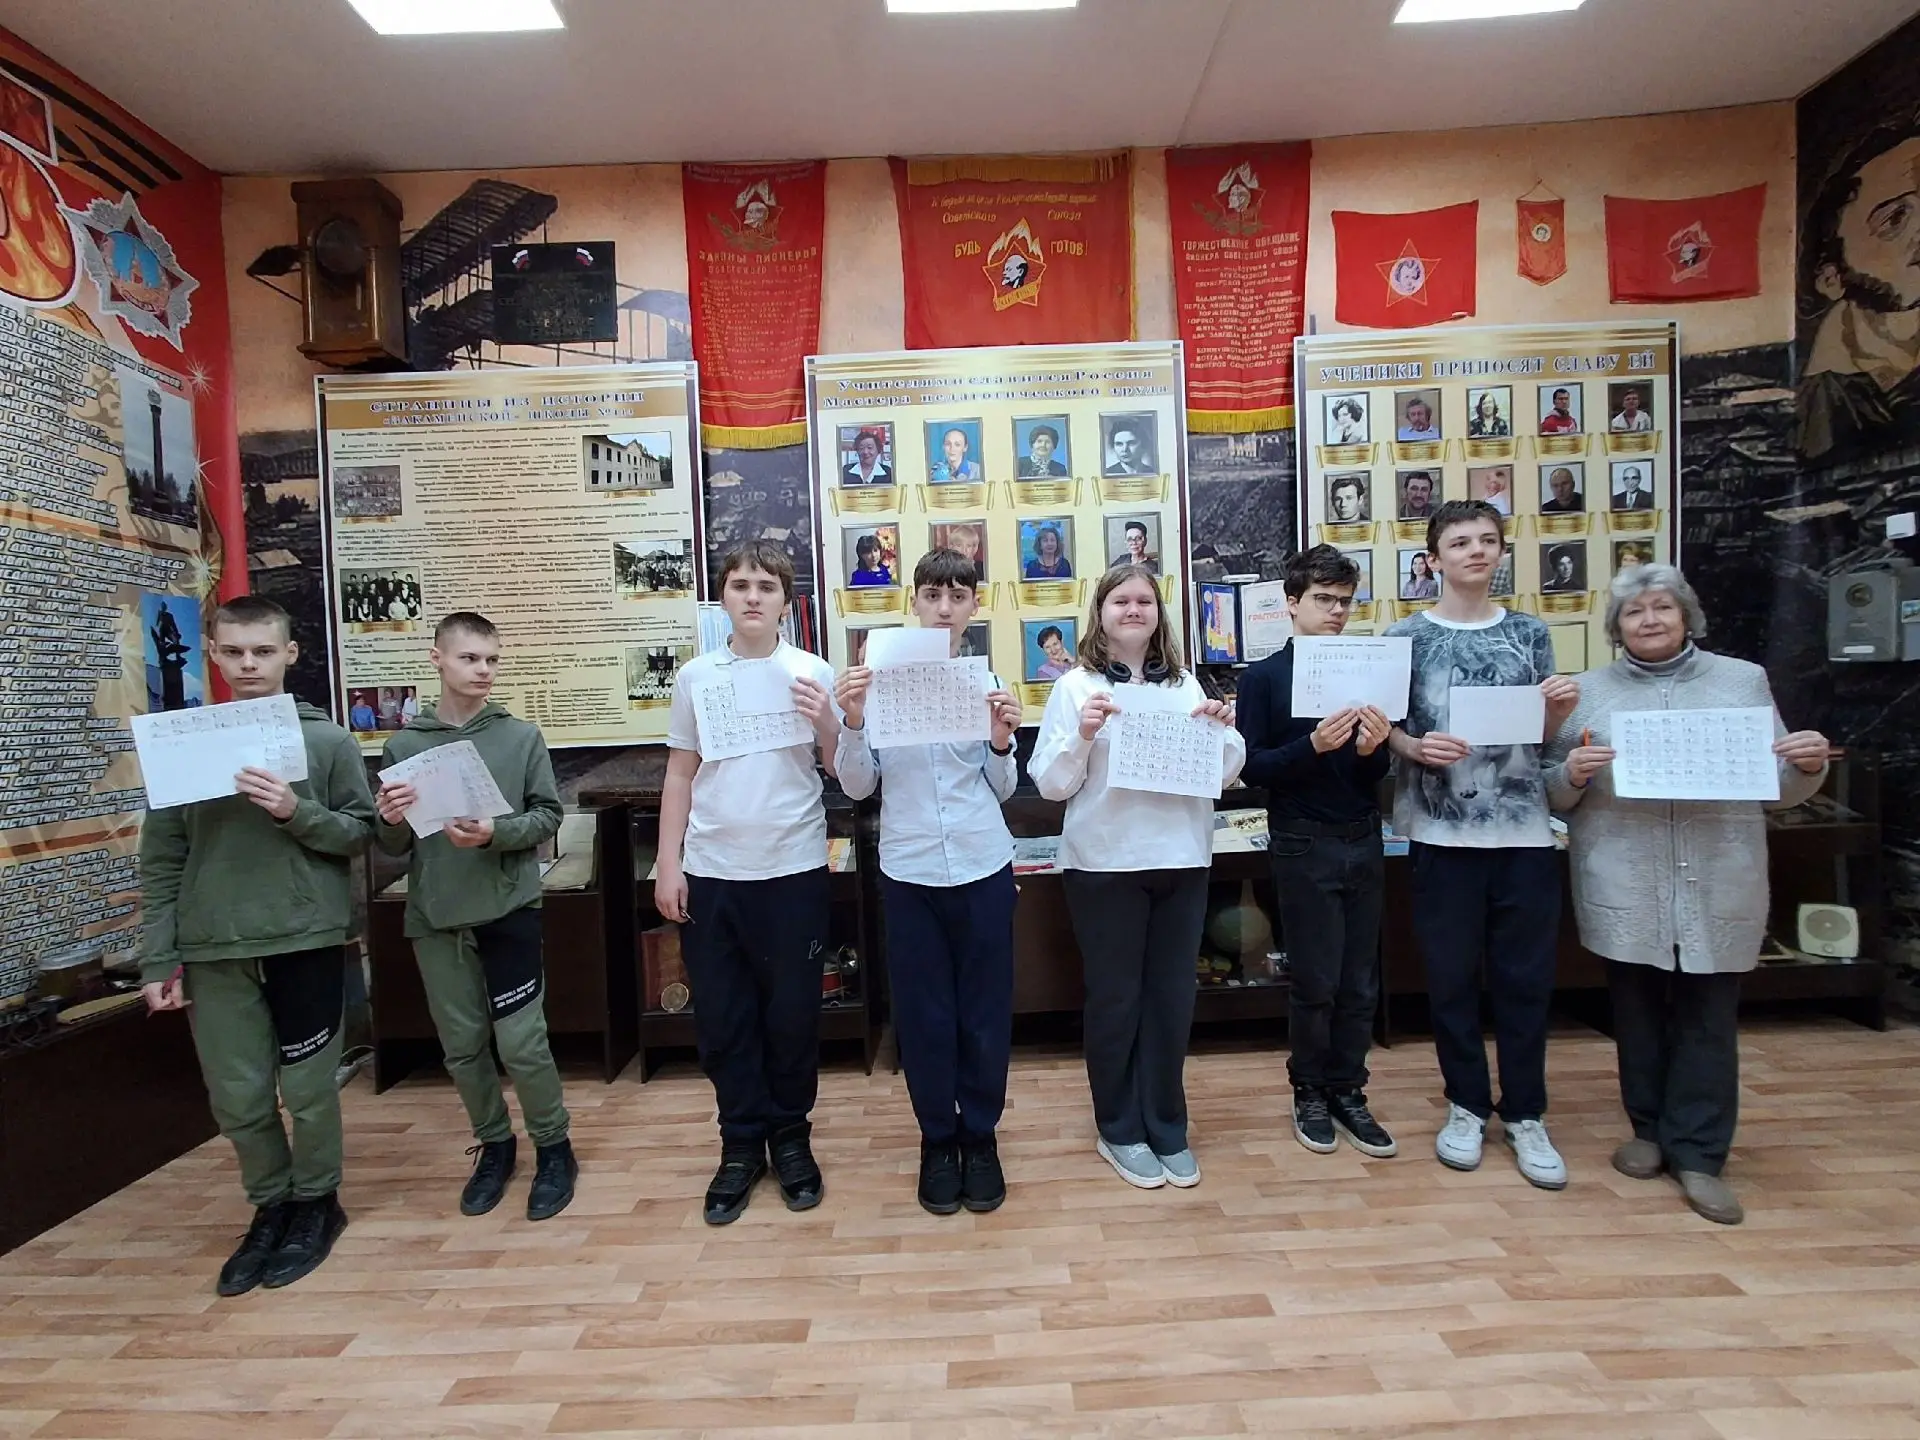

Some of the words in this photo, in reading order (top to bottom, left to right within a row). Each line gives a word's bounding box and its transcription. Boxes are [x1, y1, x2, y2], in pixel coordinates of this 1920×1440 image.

[699, 250, 748, 264] ЗАКОНЫ
[756, 246, 818, 264] ПИОНЕРОВ
[954, 240, 981, 258] БУДЬ
[1050, 239, 1088, 257] ГОТОВ!
[40, 320, 65, 337] ТОМ
[1319, 363, 1423, 384] УЧЕНИКИ
[1432, 357, 1545, 378] ПРИНОСЯТ
[1553, 354, 1620, 373] СЛАВУ
[1627, 350, 1656, 370] ЕЙ
[369, 398, 492, 414] СТРАНИЦЫ
[541, 391, 645, 407] ИСТОРИИ
[823, 394, 912, 410] Мастера
[169, 571, 178, 580] С
[4, 582, 43, 597] СТАЛИ
[12, 611, 63, 626] ТРИЖДЫ
[82, 767, 106, 780] ДВА
